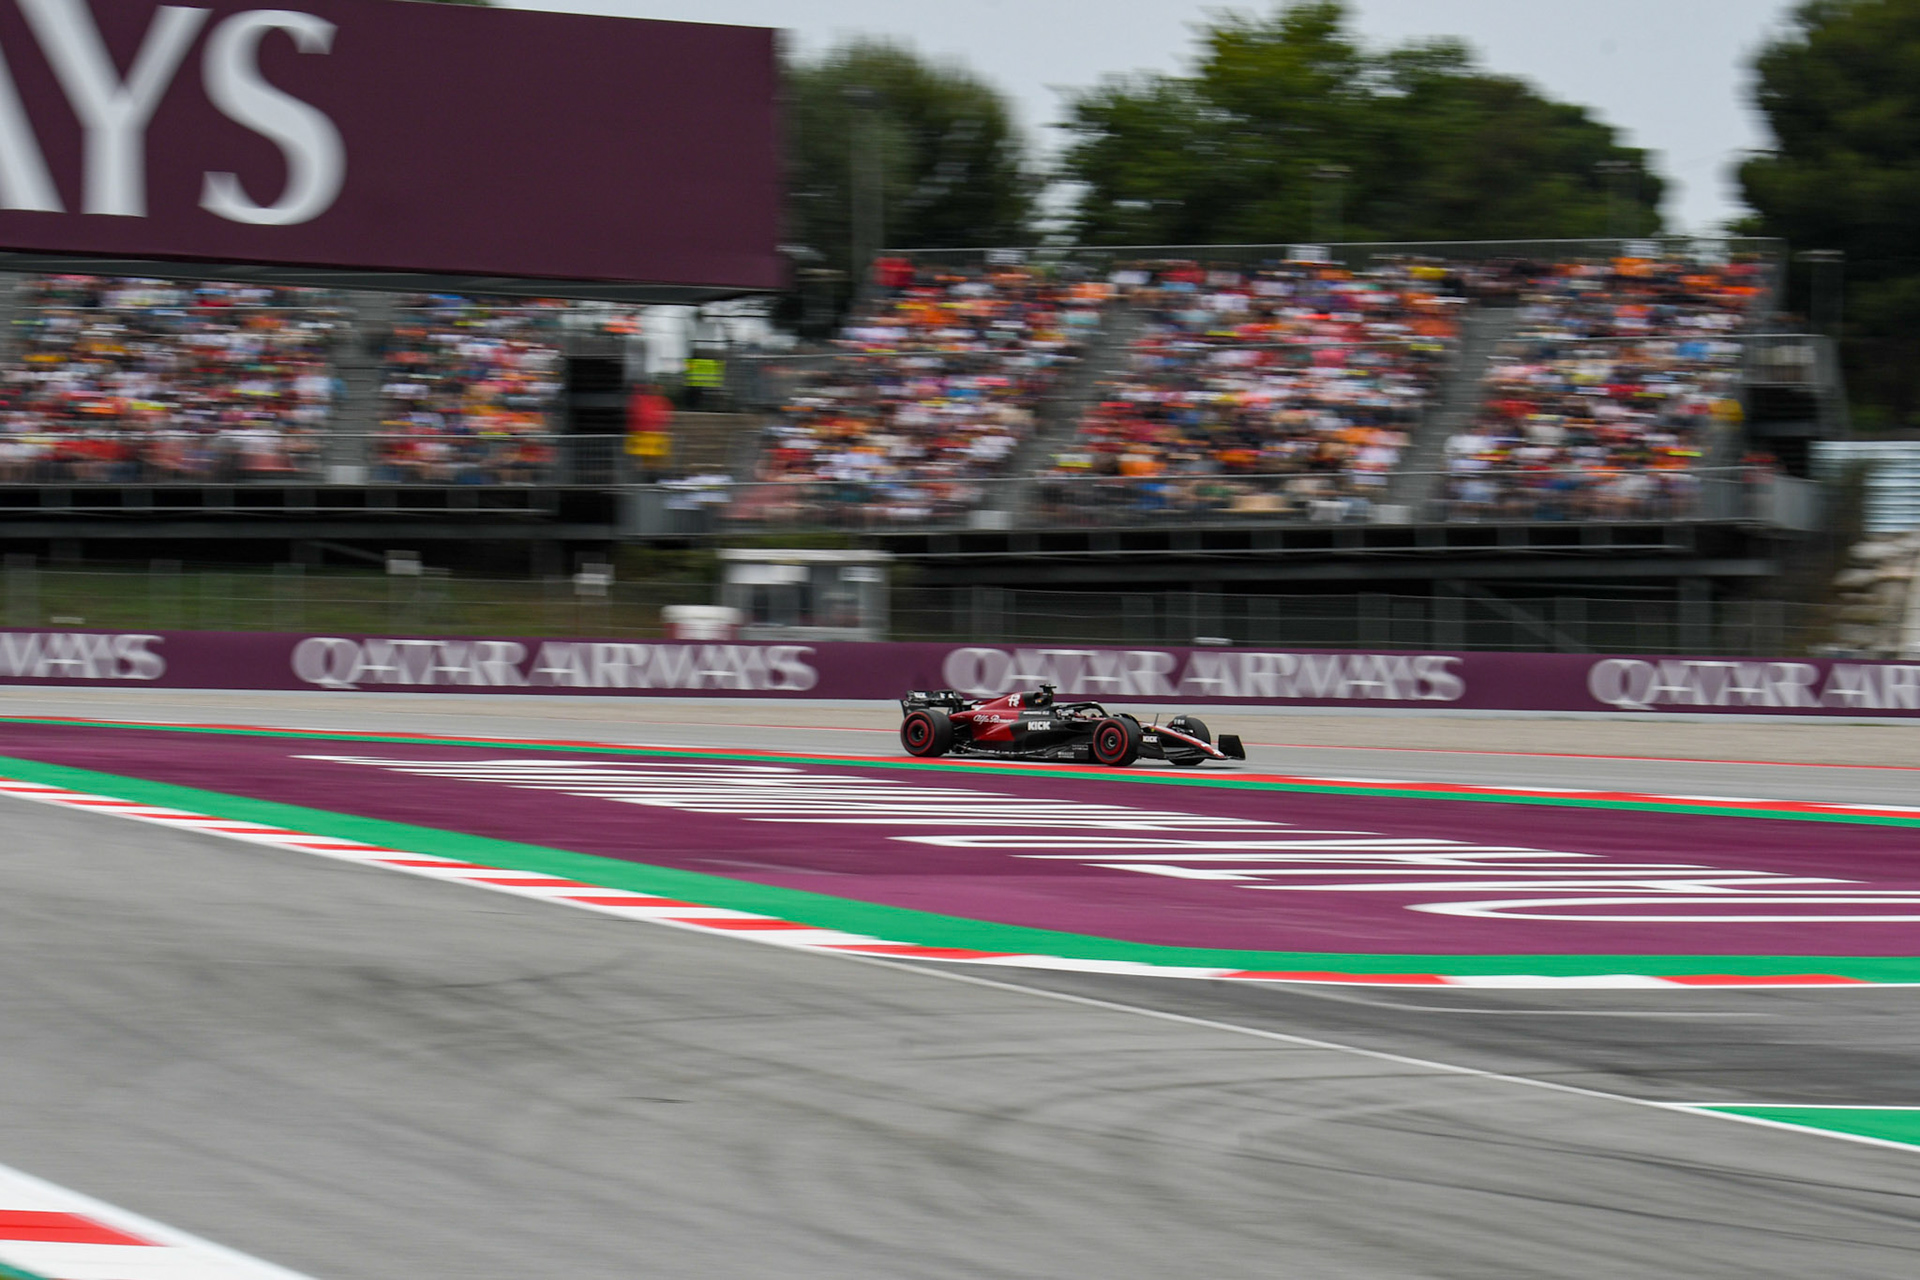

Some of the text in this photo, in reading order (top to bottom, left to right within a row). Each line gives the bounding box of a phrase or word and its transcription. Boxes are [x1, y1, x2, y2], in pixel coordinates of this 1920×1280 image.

[290, 637, 819, 691] QATAR AIRWAYS
[943, 647, 1465, 701] QATAR AIRWAYS
[1587, 658, 1822, 710] QATAR
[1027, 720, 1051, 730] KICK
